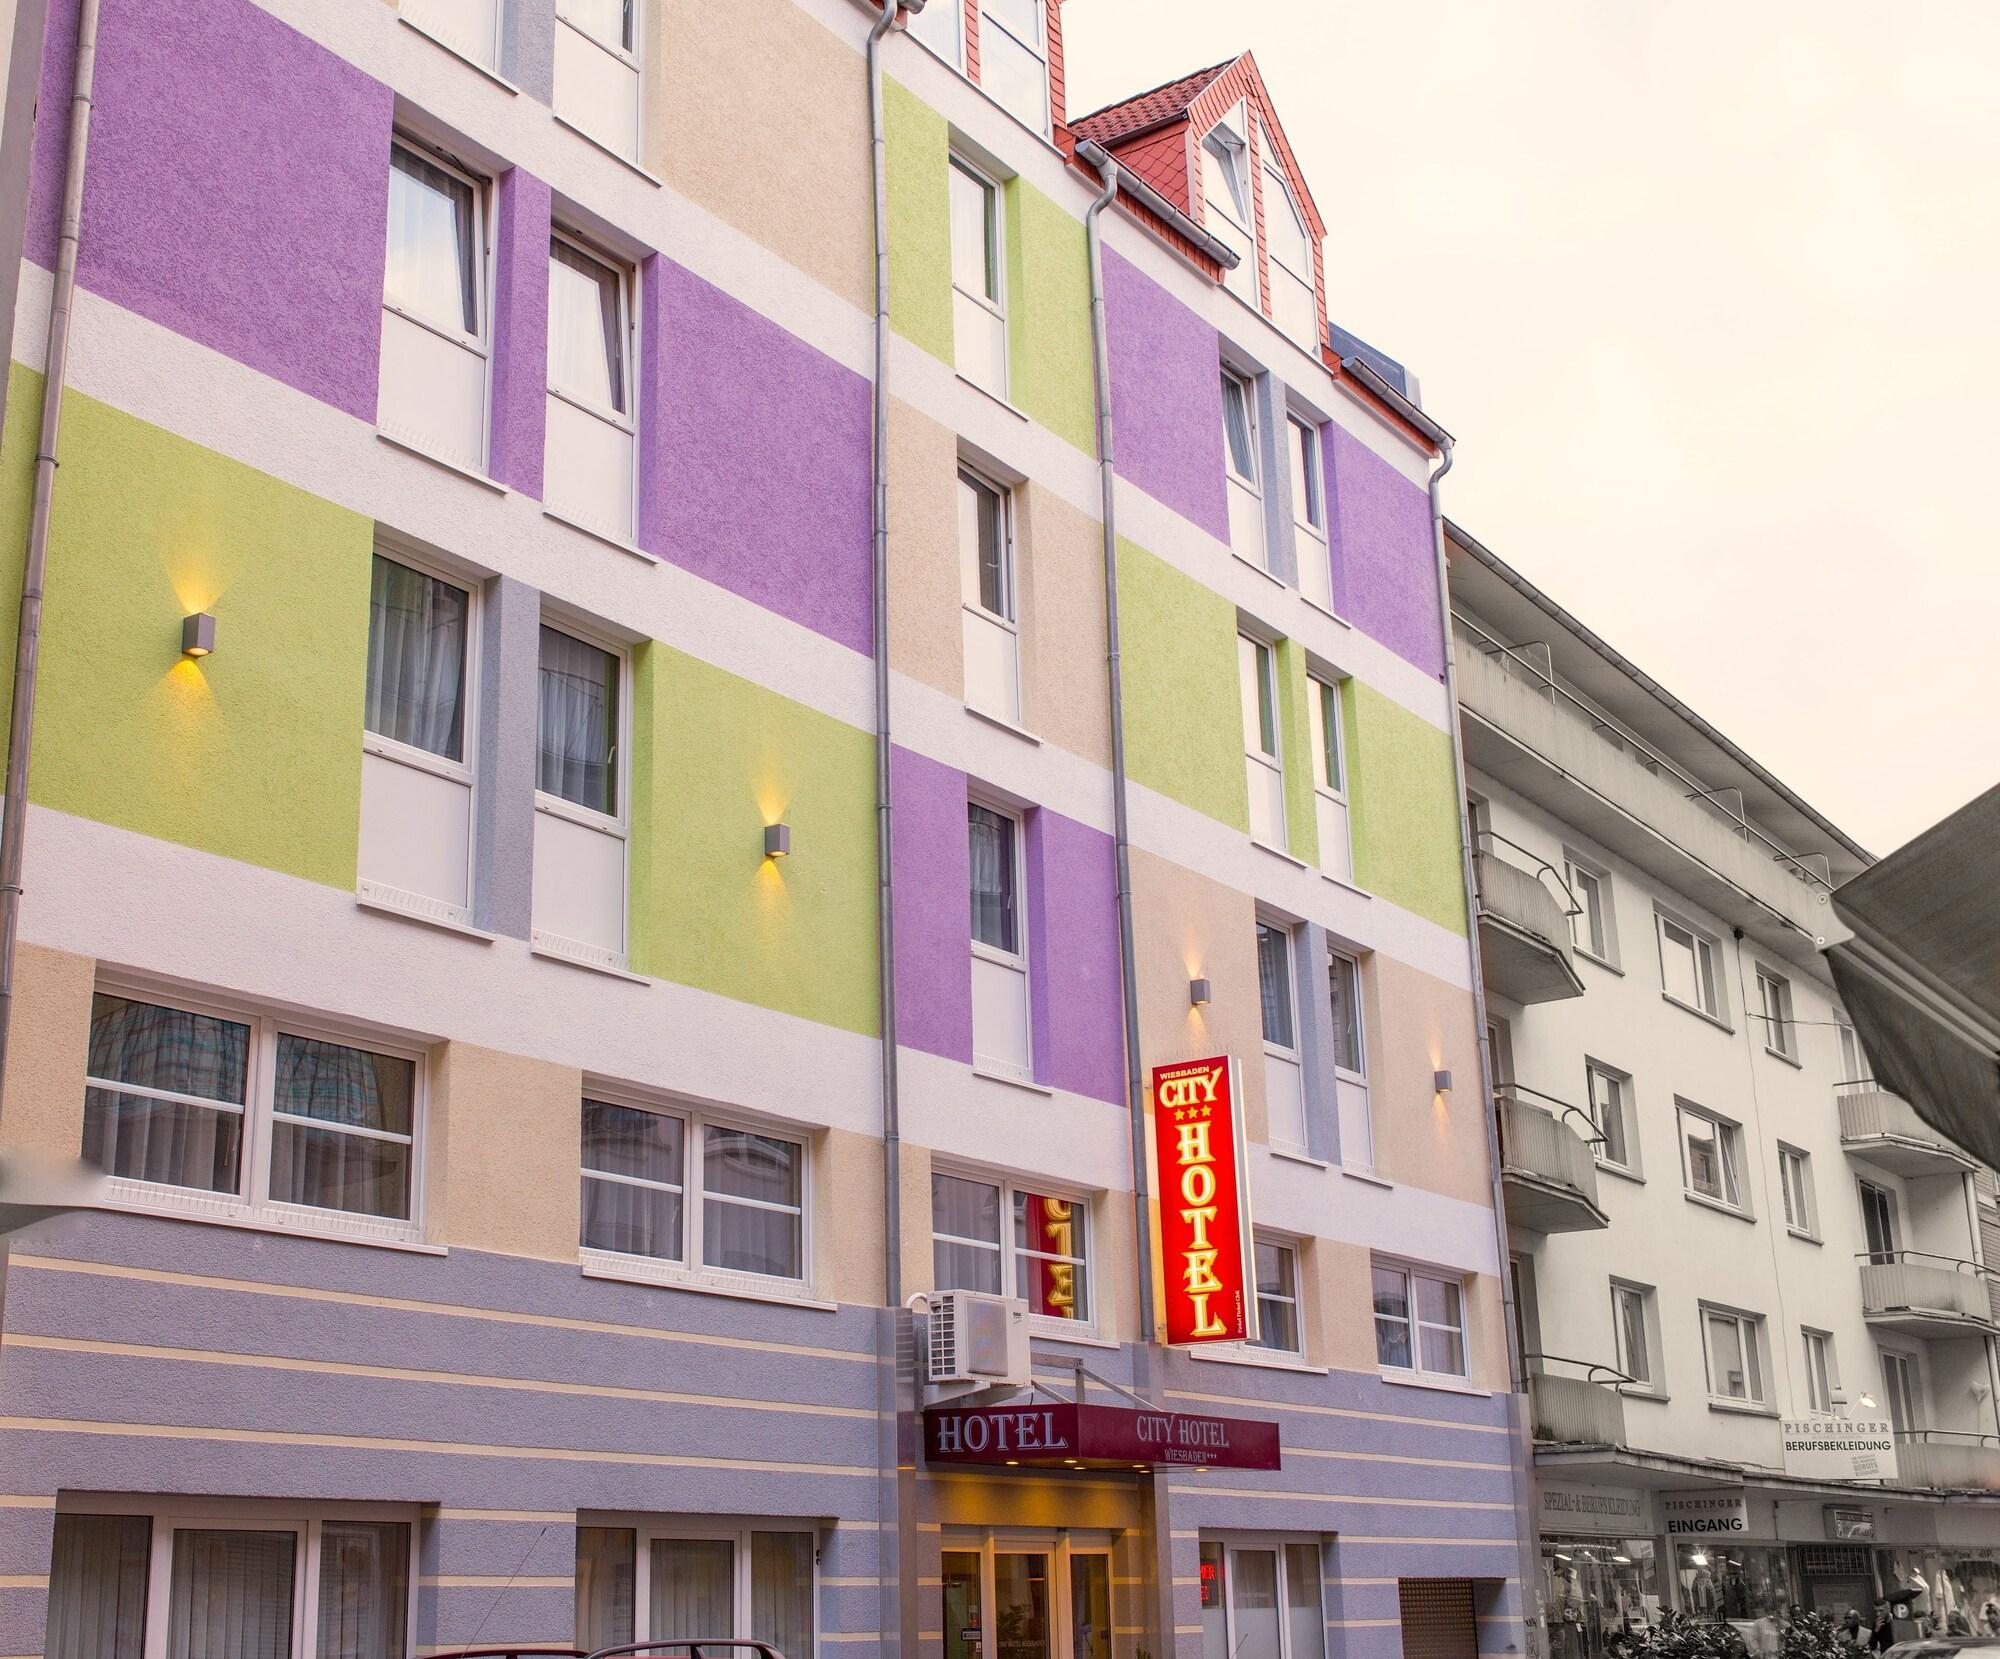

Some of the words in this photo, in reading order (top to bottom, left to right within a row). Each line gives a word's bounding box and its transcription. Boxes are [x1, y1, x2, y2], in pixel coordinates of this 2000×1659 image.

[1160, 1066, 1210, 1080] WIESBADEN
[1159, 1066, 1224, 1108] CITY
[1174, 1120, 1227, 1337] HOTEL
[937, 1412, 1069, 1453] HOTEL
[1136, 1414, 1175, 1443] CITY
[1178, 1419, 1230, 1448] HOTEL
[1784, 1422, 1889, 1434] PISCHINGER
[1785, 1440, 1891, 1451] BERUFSBEKLEIDUNG
[1665, 1498, 1742, 1510] PISCHINGER
[1668, 1518, 1743, 1533] EINGANG
